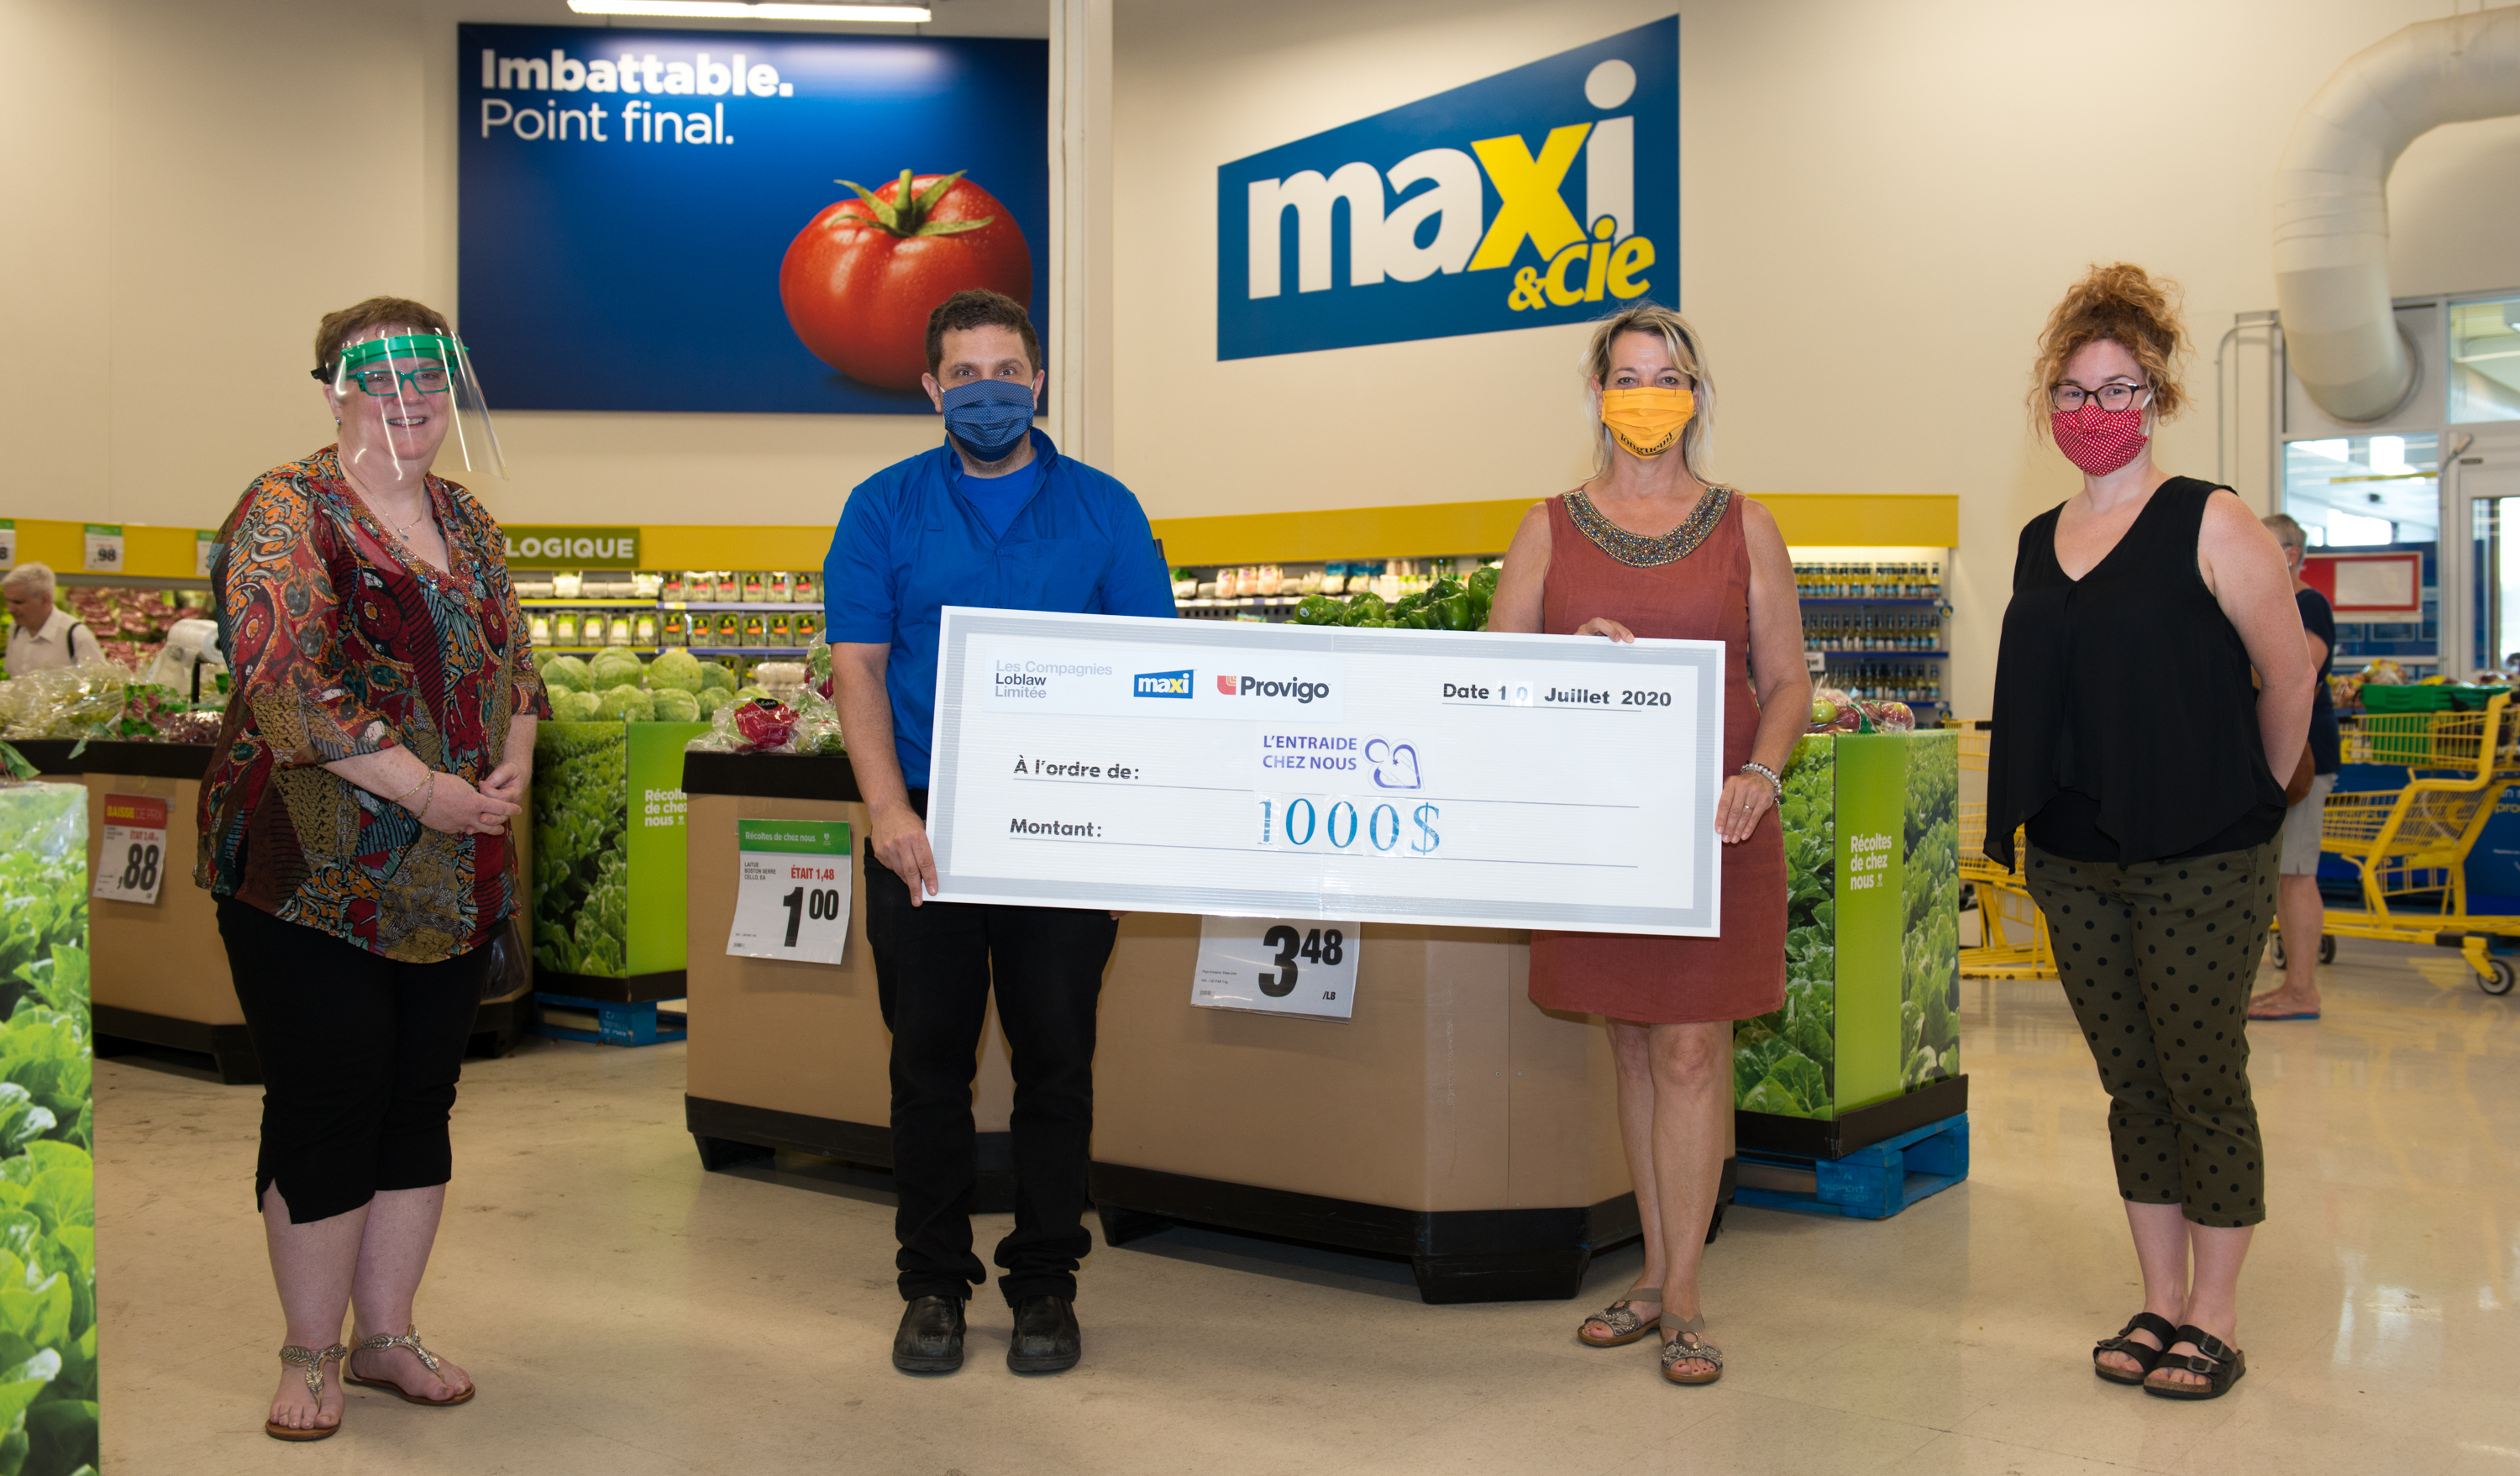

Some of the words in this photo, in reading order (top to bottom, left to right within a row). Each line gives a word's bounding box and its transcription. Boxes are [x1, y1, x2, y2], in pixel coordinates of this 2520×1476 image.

[481, 49, 794, 97] Imbattable.
[481, 98, 609, 142] Point
[622, 100, 735, 144] final.
[1248, 59, 1636, 300] maxi
[1507, 216, 1656, 311] &cie
[505, 537, 634, 559] LOGIQUE
[996, 659, 1021, 672] Les
[1025, 660, 1112, 677] Compagnies
[995, 673, 1047, 685] Loblaw
[1138, 673, 1189, 694] maxi
[995, 685, 1047, 698] Limitée
[1241, 676, 1330, 704] Provigo
[1443, 683, 1489, 699] Date
[1544, 687, 1610, 705] Juillet
[1620, 690, 1672, 706] 2020
[1263, 735, 1357, 750] L'ENTRAIDE
[1013, 755, 1028, 774] À
[1035, 759, 1100, 778] l'ordre
[1263, 755, 1305, 769] CHEZ
[1310, 757, 1357, 770] NOUS
[645, 788, 687, 801] Récolte
[107, 806, 134, 819] BAISSE
[135, 807, 146, 820] DE
[147, 808, 163, 821] PRIX
[644, 801, 660, 815] de
[644, 816, 674, 827] nous
[1257, 797, 1440, 855] 1000$
[745, 832, 773, 841] Récoltes
[774, 832, 783, 841] de
[783, 833, 799, 842] chez
[1851, 833, 1892, 854] Récoltes
[1851, 854, 1864, 872] de
[1866, 851, 1887, 870] chez
[790, 864, 814, 880] ÉTAIT
[816, 869, 835, 882] 1,48
[1851, 874, 1874, 890] nous
[1322, 990, 1336, 1001] /LB
